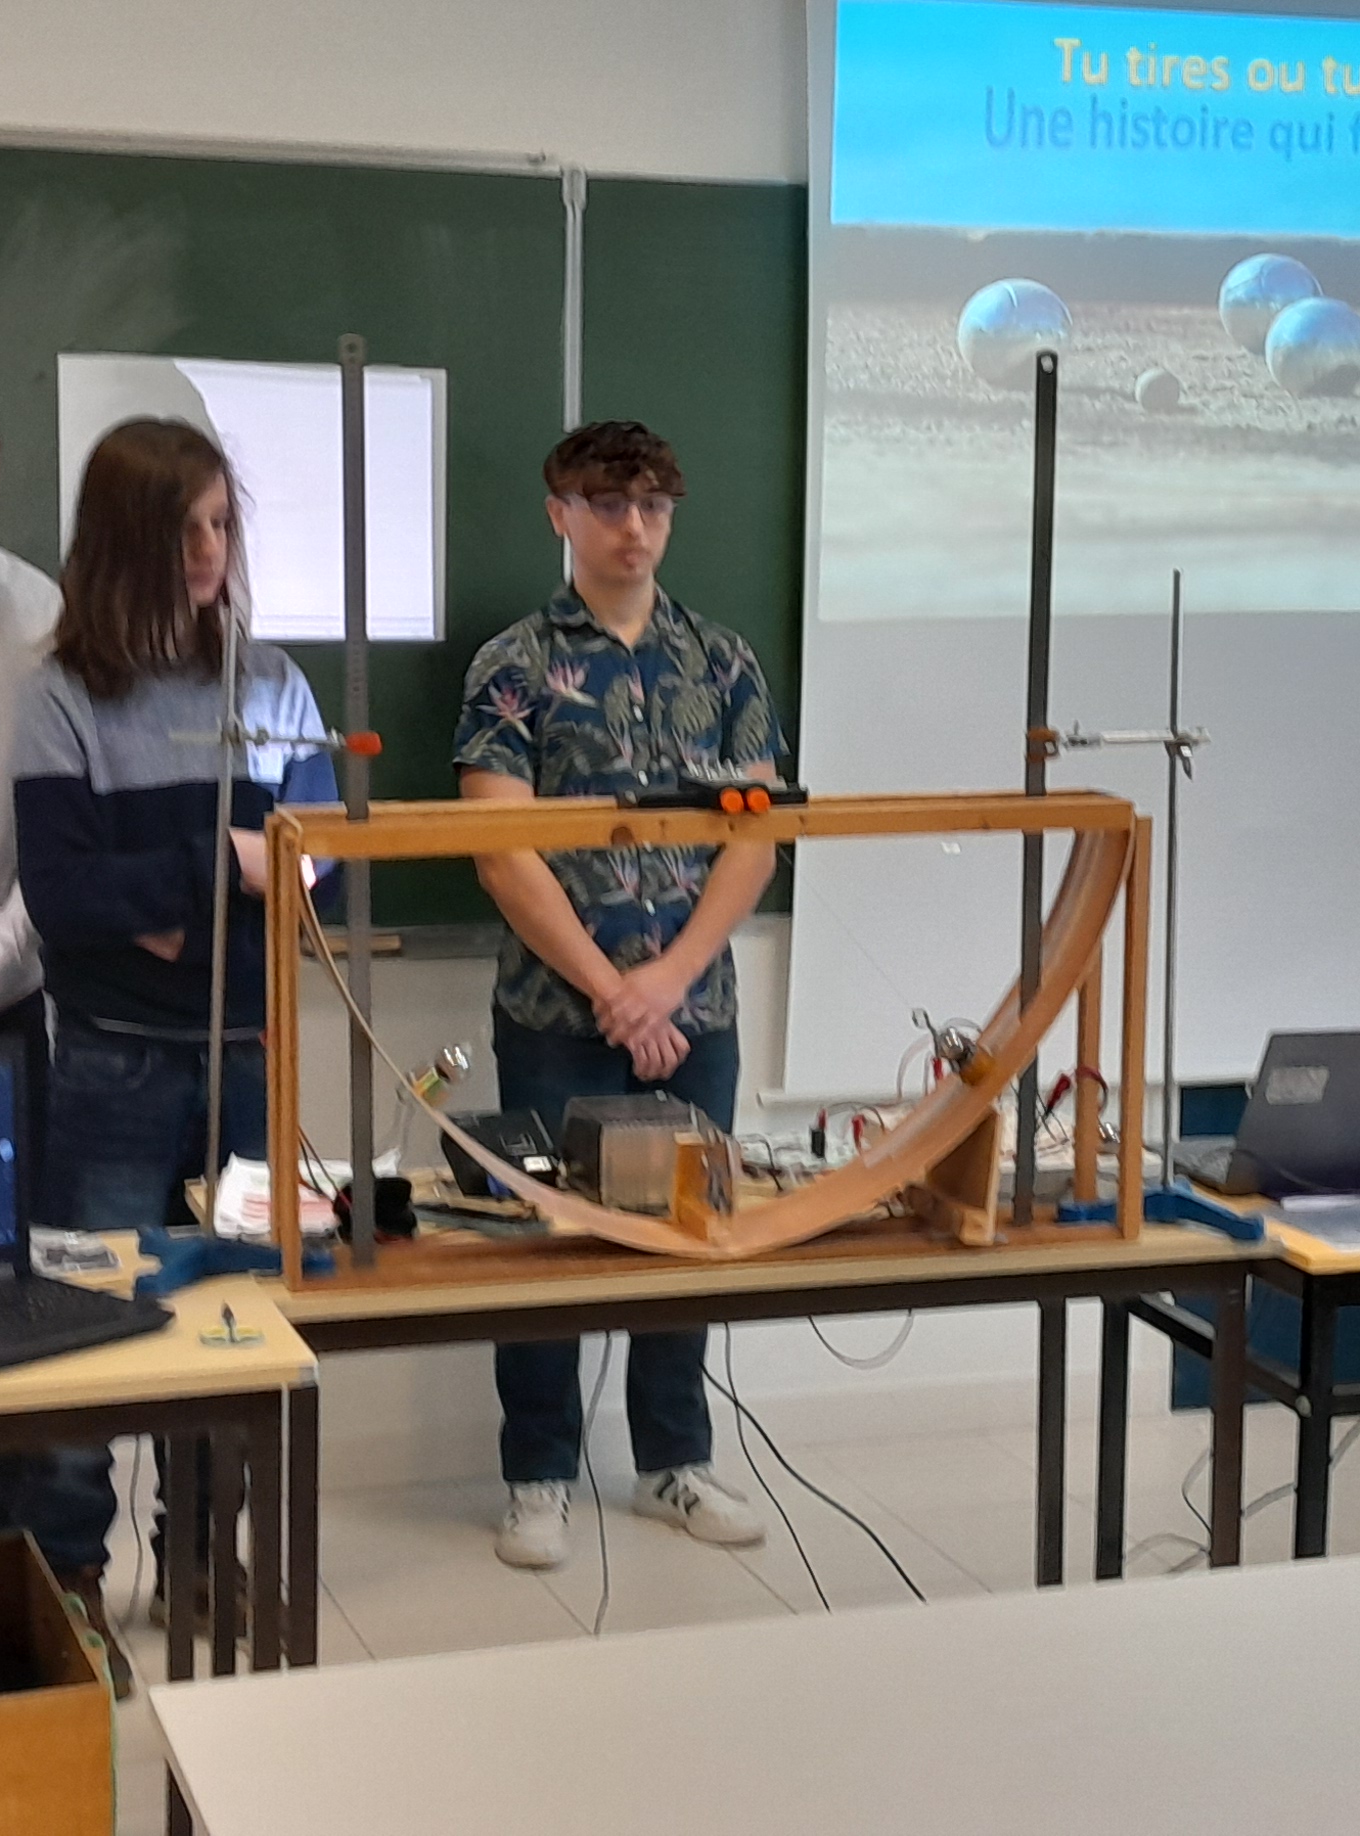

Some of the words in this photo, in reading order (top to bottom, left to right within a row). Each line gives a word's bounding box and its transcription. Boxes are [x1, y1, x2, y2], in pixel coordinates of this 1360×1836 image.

[1052, 36, 1110, 87] Tu
[1125, 40, 1232, 92] tires
[1246, 57, 1307, 93] ou
[984, 85, 1074, 149] Une
[1089, 92, 1255, 150] histoire
[1269, 110, 1335, 162] qui
